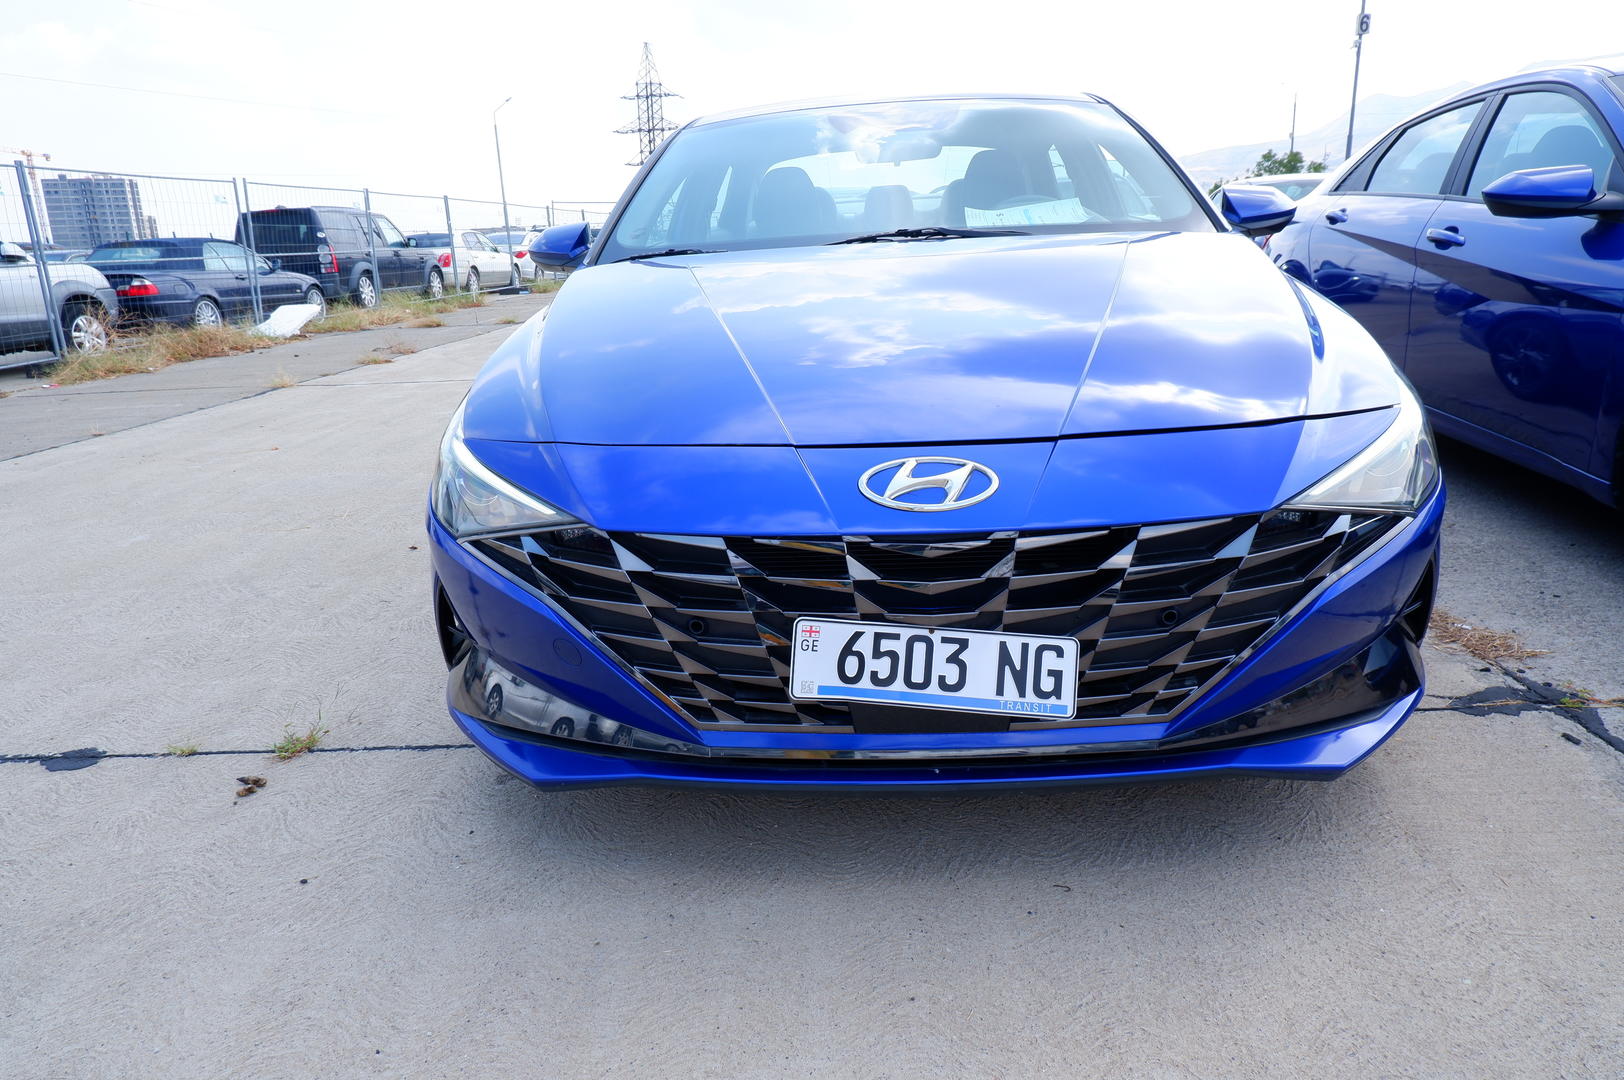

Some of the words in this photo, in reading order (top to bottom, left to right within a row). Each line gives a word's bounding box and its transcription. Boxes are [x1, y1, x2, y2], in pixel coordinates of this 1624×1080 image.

[1360, 14, 1370, 33] 6
[800, 638, 819, 652] GE
[836, 630, 970, 693] 6503
[995, 640, 1065, 701] NG
[1000, 700, 1053, 713] TRANSIT
